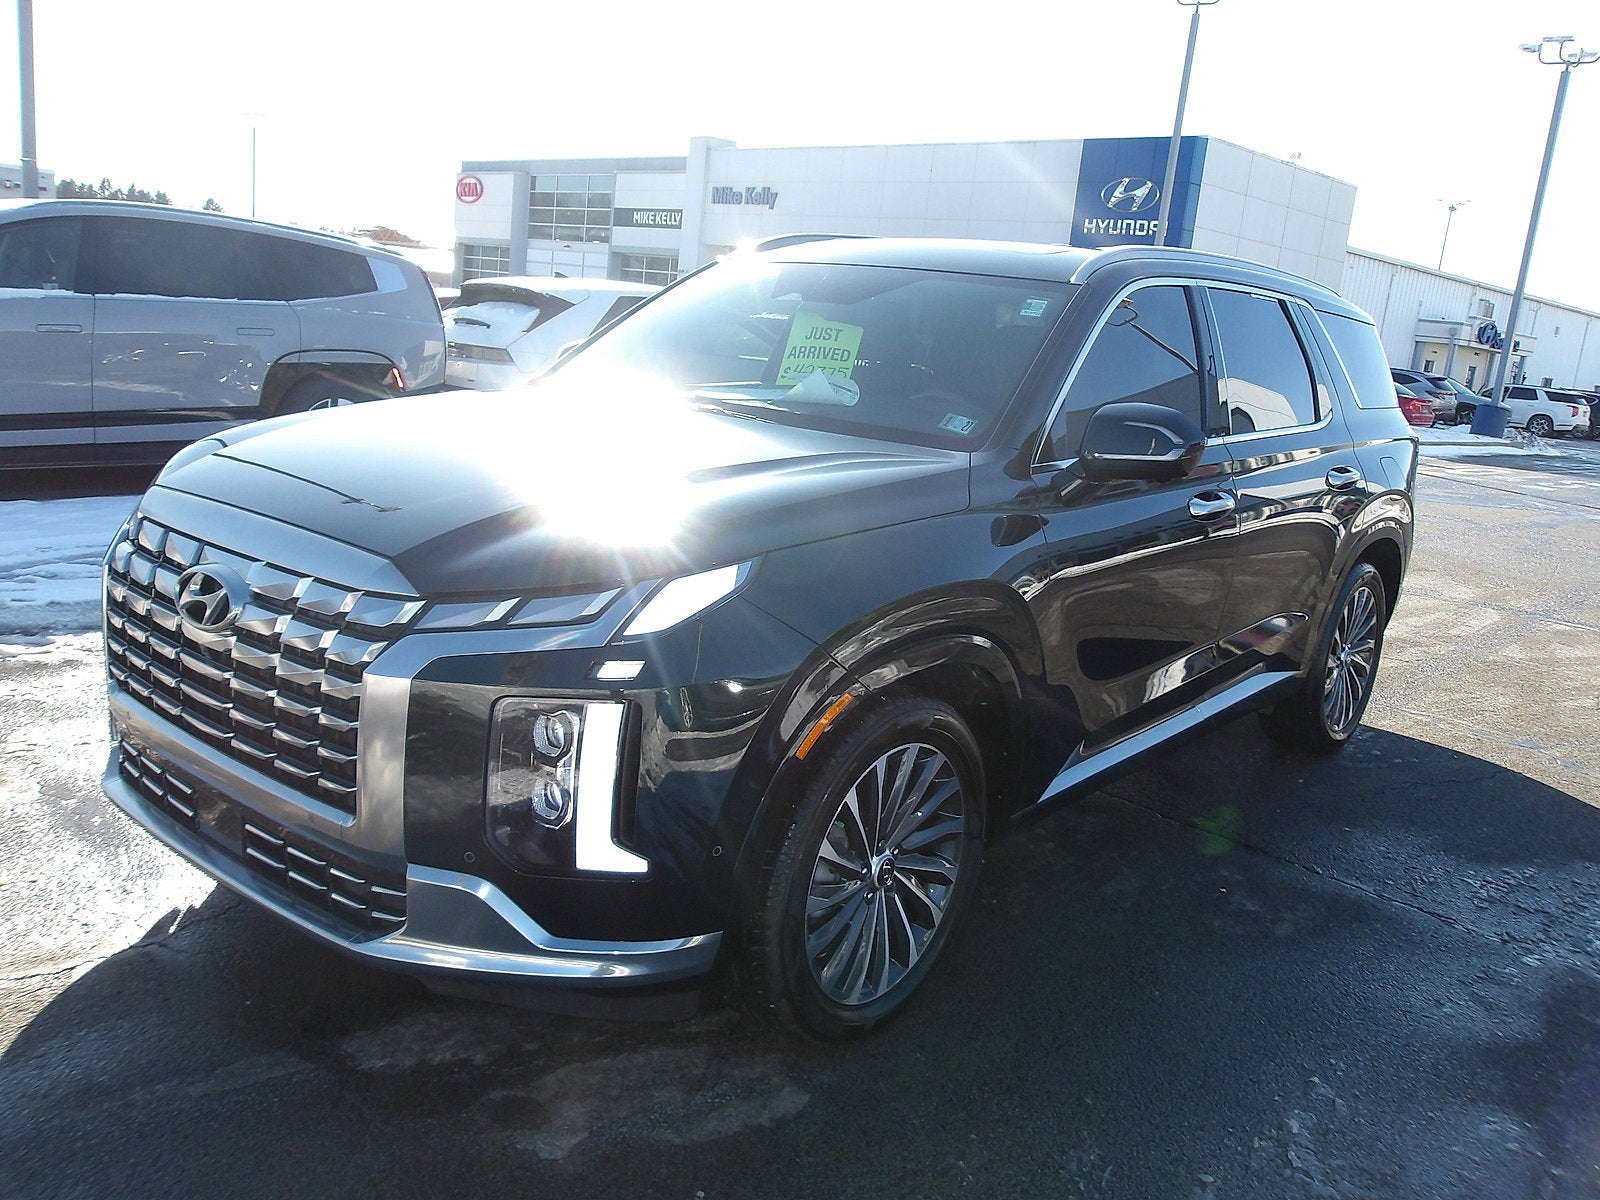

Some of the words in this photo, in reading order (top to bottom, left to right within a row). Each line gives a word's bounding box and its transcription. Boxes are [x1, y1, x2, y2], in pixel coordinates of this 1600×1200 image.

[459, 182, 479, 198] KIA
[711, 186, 743, 205] Mike
[744, 186, 778, 210] Kelly
[633, 211, 655, 225] MIKE
[655, 211, 682, 226] KELLY
[1083, 218, 1168, 237] HYUNDA
[805, 327, 843, 341] JUST
[787, 345, 851, 362] ARRIVED
